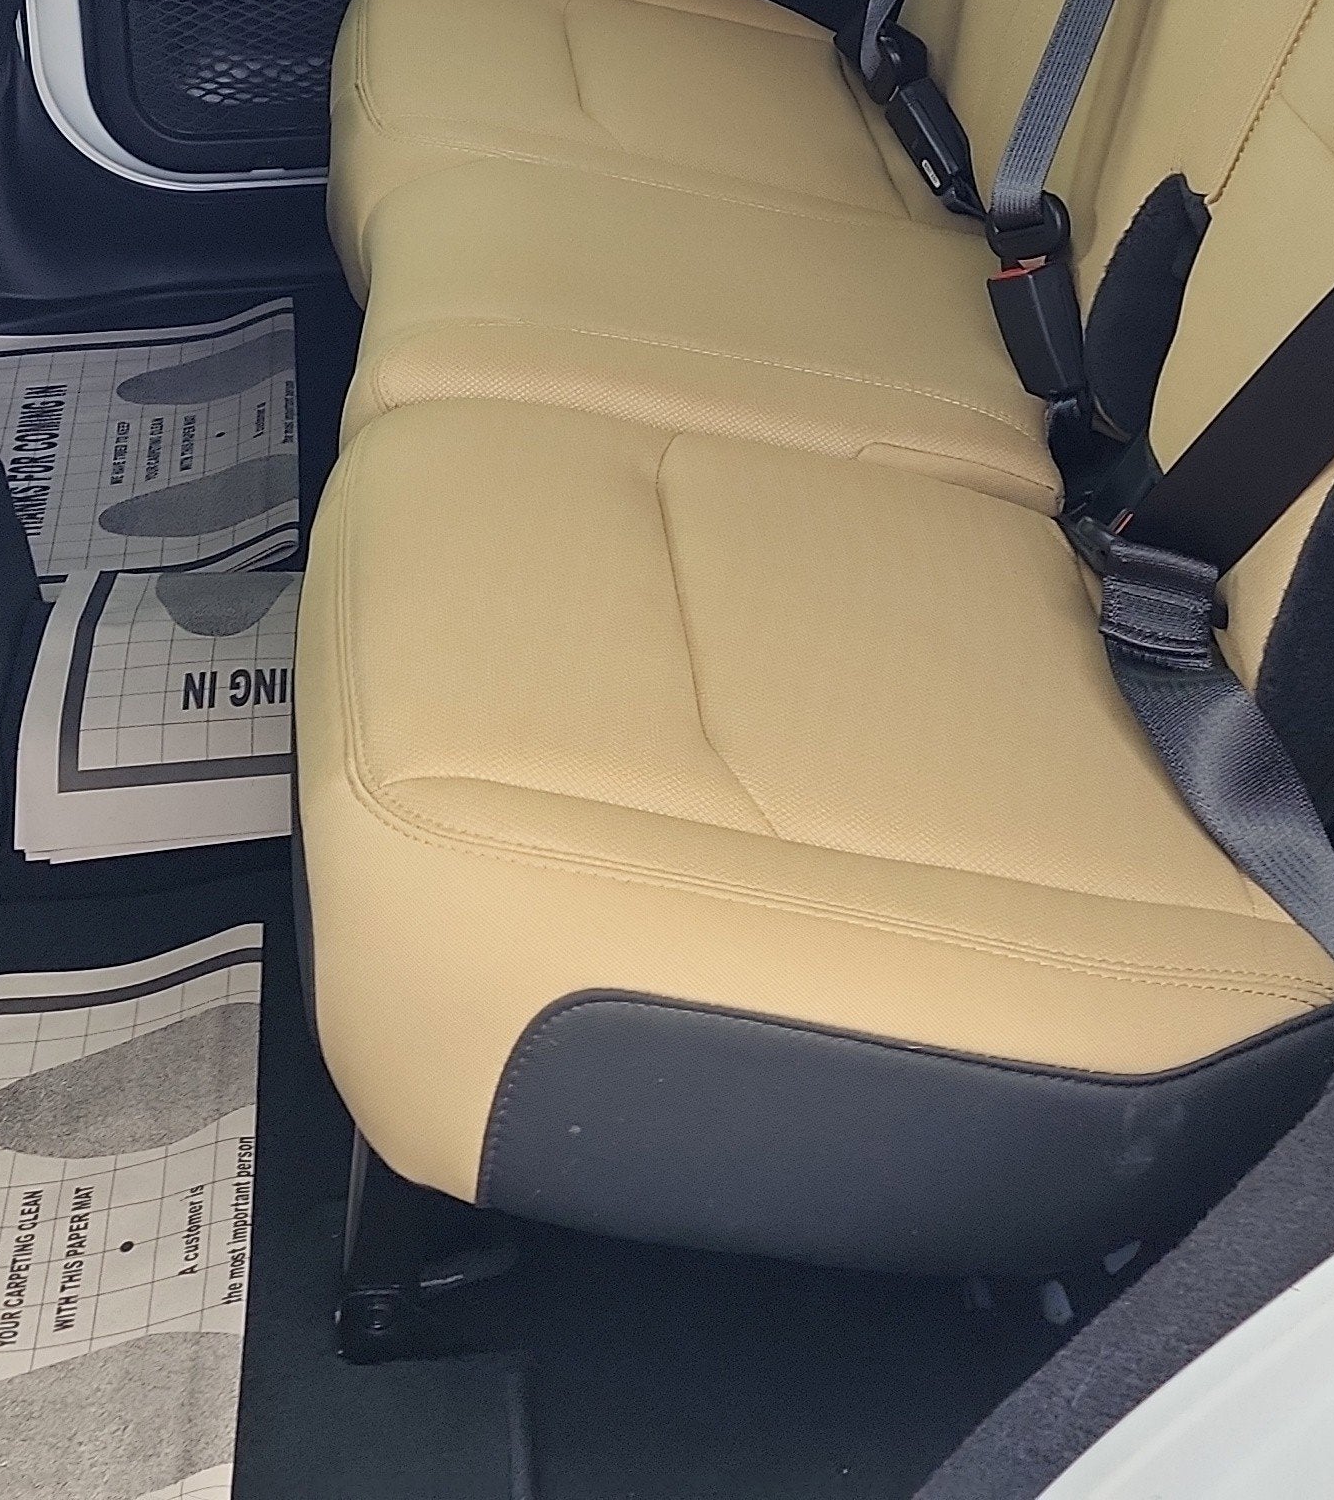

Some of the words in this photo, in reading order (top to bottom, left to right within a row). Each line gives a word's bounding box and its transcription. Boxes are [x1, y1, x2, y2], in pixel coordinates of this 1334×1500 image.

[24, 384, 68, 399] IN
[12, 400, 65, 452] COMING
[116, 422, 130, 435] KEEP
[7, 453, 56, 482] FOR
[110, 475, 124, 486] WE
[182, 671, 217, 710] IN
[229, 668, 288, 707] ING
[236, 1136, 255, 1178] person
[18, 1189, 43, 1231] CLEAN
[71, 1186, 96, 1212] MAT
[179, 1184, 205, 1201] is
[226, 1180, 251, 1245] important
[66, 1212, 90, 1259] PAPER
[182, 1200, 204, 1262] customer
[4, 1233, 35, 1308] CARPETING
[60, 1260, 84, 1293] THIS
[178, 1264, 199, 1276] A
[227, 1246, 247, 1279] most
[222, 1282, 243, 1305] the
[53, 1294, 79, 1333] WITH
